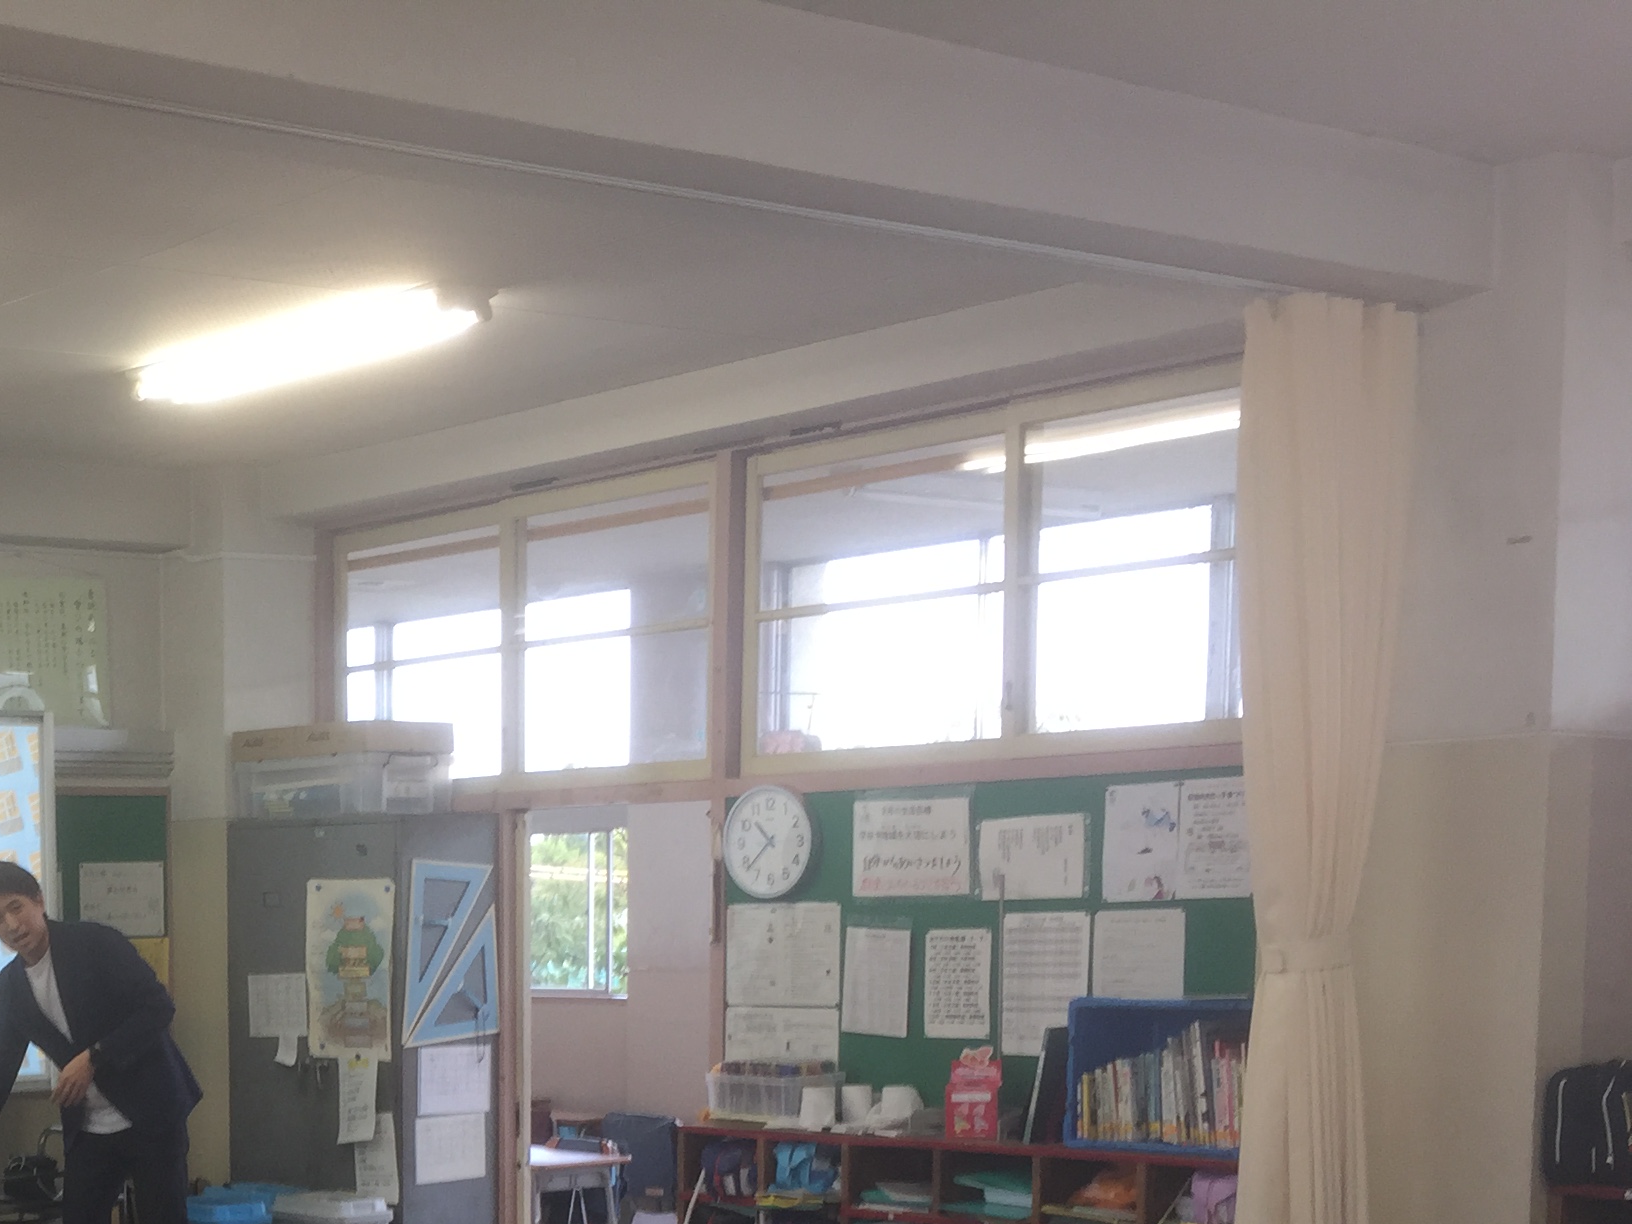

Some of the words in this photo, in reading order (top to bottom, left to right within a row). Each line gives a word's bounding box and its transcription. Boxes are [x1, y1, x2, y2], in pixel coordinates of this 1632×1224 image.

[766, 798, 776, 811] 12
[784, 802, 788, 816] 1
[792, 814, 800, 829] 2
[796, 834, 805, 848] 3
[792, 853, 800, 866] 4
[754, 868, 761, 881] 7
